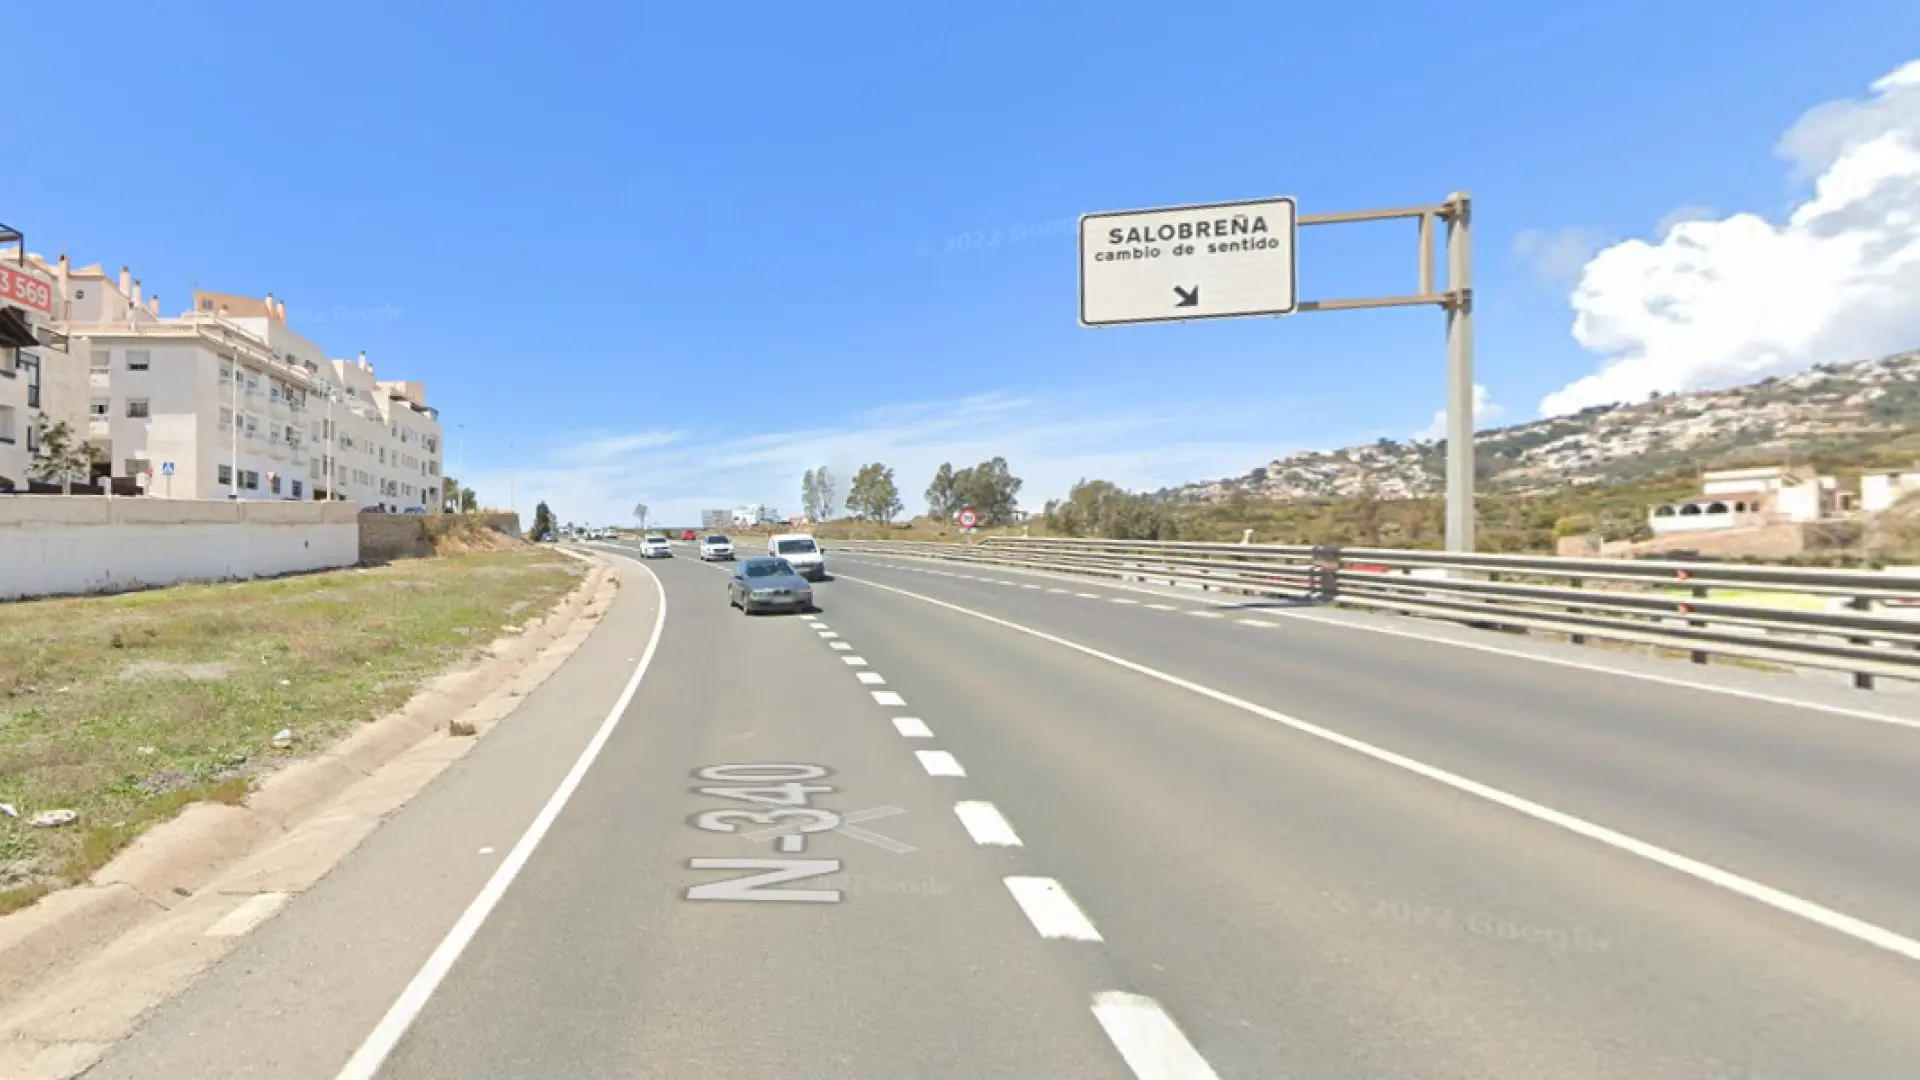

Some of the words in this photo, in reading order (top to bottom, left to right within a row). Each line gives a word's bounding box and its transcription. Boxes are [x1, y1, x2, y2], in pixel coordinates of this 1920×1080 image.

[1108, 213, 1269, 245] SALOBREÑA
[1094, 245, 1161, 262] cambio
[1172, 242, 1196, 257] de
[1208, 235, 1280, 254] sentido
[15, 276, 48, 307] 569
